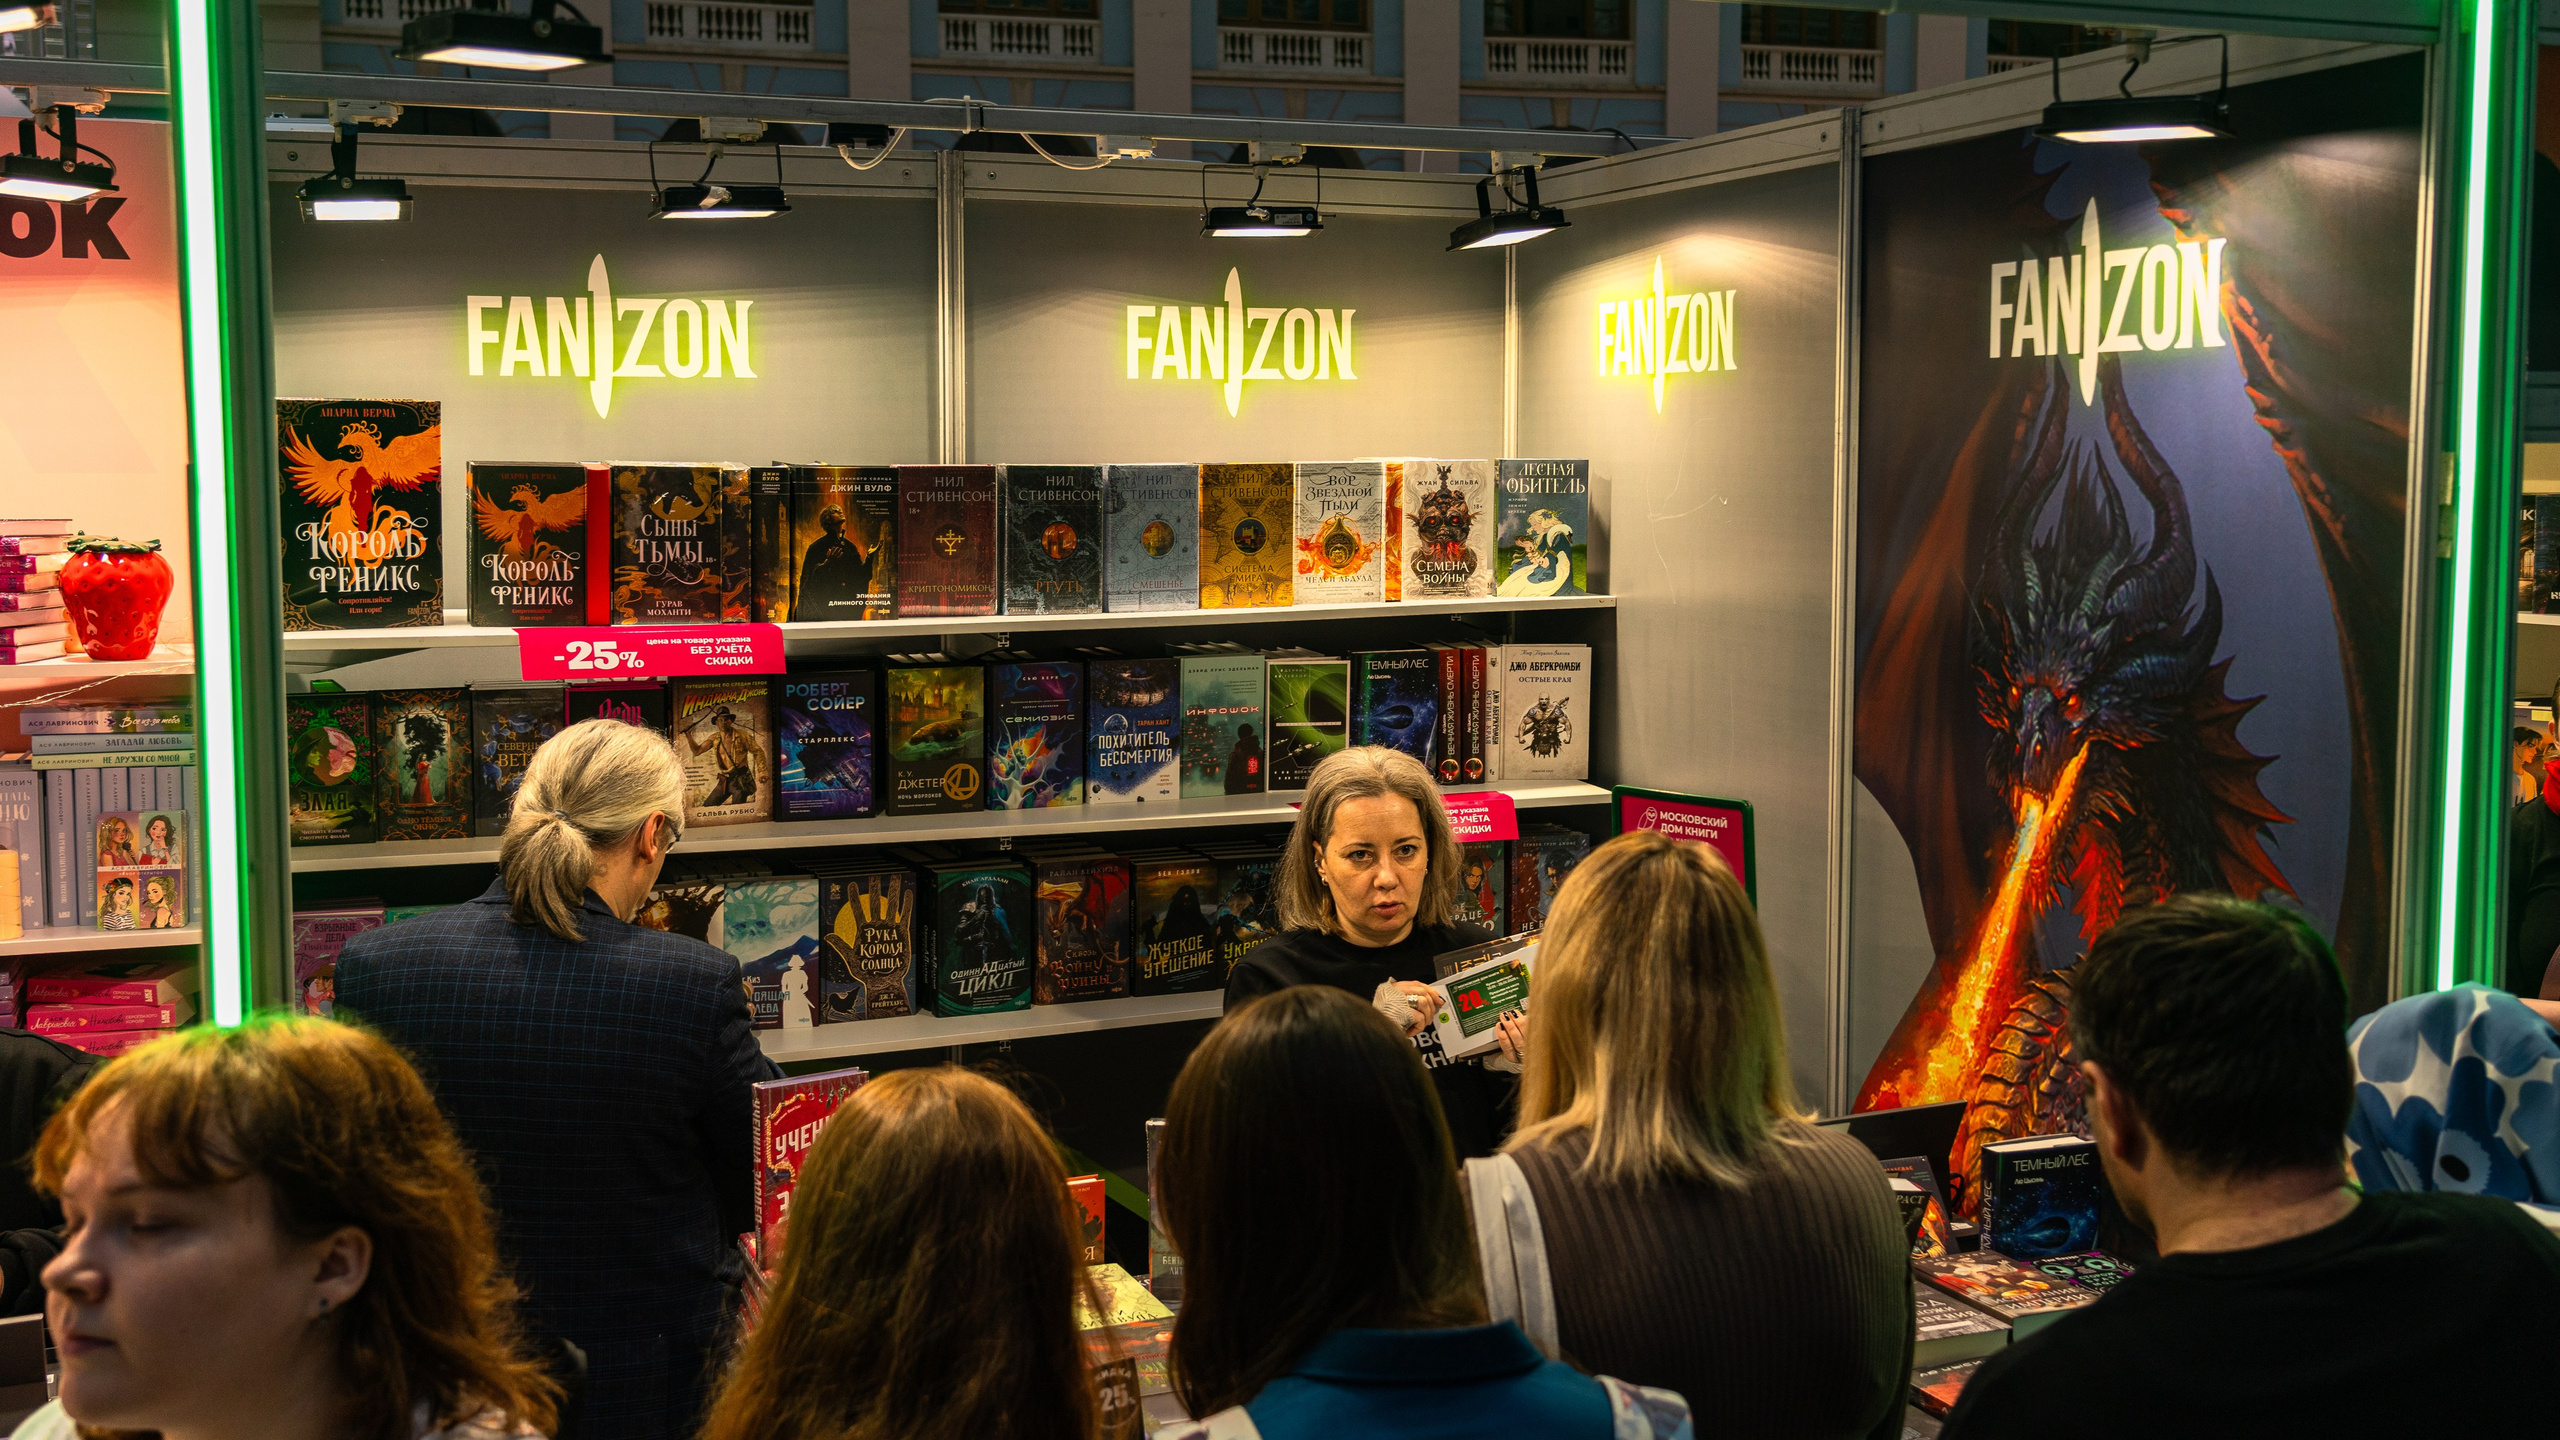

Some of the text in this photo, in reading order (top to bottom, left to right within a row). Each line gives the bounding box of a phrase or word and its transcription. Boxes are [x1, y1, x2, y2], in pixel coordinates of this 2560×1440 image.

[1990, 230, 2227, 364] FANZON
[467, 288, 758, 389] FANZON
[1599, 283, 1738, 386] FANZON
[1126, 297, 1358, 391] FANZON
[319, 407, 396, 418] АПАРНА ВЕРМА
[1518, 463, 1575, 476] ЛЕСНАЯ
[935, 476, 964, 487] НИЛ
[1046, 475, 1074, 486] НИЛ
[1146, 474, 1172, 486] НИЛ
[1237, 473, 1264, 484] НИЛ
[1324, 474, 1357, 487] ВОР
[864, 484, 892, 492] ВУЛФ
[1210, 486, 1289, 498] СТИВЕНСОН
[1506, 477, 1586, 494] ОБИТЕЛЬ
[906, 490, 992, 502] СТИВЕНСОН
[1018, 490, 1100, 501] СТИВЕНСОН
[1120, 488, 1197, 500] СТИВЕНСОН
[1305, 484, 1374, 501] ЗВЕЗДНОЙ
[1224, 564, 1274, 574] СИСТЕМА
[1416, 560, 1470, 573] СЕМЕНА
[309, 564, 421, 594] ФЕНИКС
[1235, 574, 1263, 582] МИРА
[1423, 571, 1465, 584] ВОЙНЫ
[908, 583, 991, 594] КРИПТОНОМИКОН
[1035, 580, 1083, 594] РТУТЬ
[1132, 580, 1184, 590] СМЕШЕНЬЕ
[490, 586, 574, 606] ФЕНИКС
[655, 600, 683, 608] ГУРАВ
[865, 599, 891, 607] СОЛНЦА
[350, 606, 382, 615] Или гори!
[647, 608, 692, 617] МОХАНТИ
[646, 637, 666, 646] цена
[682, 636, 714, 645] товаре
[715, 635, 751, 645] указана
[690, 642, 753, 655] БЕЗ УЧЁТА
[553, 640, 645, 671] -25%
[704, 655, 754, 667] СКИДКИ
[1366, 658, 1429, 671] ТЕМНЫЙ ЛЕС
[1509, 661, 1581, 672] ДЖО АБЕРКРОМБИ
[785, 682, 850, 698] РОБЕРТ
[681, 687, 768, 719] ИНДИАНА ДЖОНС
[806, 693, 866, 712] СОЙЕР
[1446, 654, 1455, 756] ВЕЧНАЯ ЖИЗНЬ СМЕРТИ
[1471, 654, 1480, 755] ВЕЧНАЯ ЖИЗНЬ СМЕРТИ
[1186, 705, 1260, 716] ИНФОШОК
[1492, 689, 1500, 745] ДЖО АБЕРКРОМБИ
[45, 719, 99, 727] ЛАВРИНОВИЧ
[119, 716, 140, 728] Все
[1005, 714, 1075, 723] СЕМИОЗИС
[1137, 719, 1155, 727] ТАРАН
[105, 738, 145, 747] ЗАГАДАЙ
[147, 736, 182, 745] ЛЮБОВЬ
[798, 736, 856, 744] СТАРПЛЕКС
[1098, 730, 1171, 750] ПОХИТИТЕЛЬ
[102, 755, 113, 764] НЕ
[114, 754, 144, 764] ДРУЖИ
[145, 754, 156, 763] СО
[157, 752, 180, 762] МНОЙ
[498, 753, 534, 767] ВЕТ
[1100, 748, 1173, 767] БЕССМЕРТИЯ
[907, 770, 914, 778] У.
[897, 778, 946, 791] ДЖЕТЕР
[301, 791, 348, 811] ЗЛАЯ
[730, 808, 755, 816] РУБИО
[397, 814, 452, 825] ОДНО ТЁМНОЕ
[1659, 810, 1728, 828] МОСКОВСКИЙ
[413, 823, 438, 831] ОКНО
[1452, 824, 1492, 835] СКИДКИ
[1660, 823, 1718, 839] ДОМ КНИГИ
[1176, 868, 1201, 876] ГЭЛЛИ
[314, 922, 357, 933] ВЗРЫВНЫЕ
[325, 933, 347, 943] ДЕЛА
[863, 928, 898, 943] РУКА
[860, 942, 903, 958] КОРОЛЯ
[1148, 935, 1204, 961] ЖУТКОЕ
[861, 957, 902, 973] СОЛНЦА
[1143, 949, 1214, 979] УТЕШЕНИЕ
[958, 971, 1014, 996] ЦИКЛ
[754, 1002, 779, 1014] ЛЕВА
[752, 1098, 762, 1164] УЧЕНИЦА
[2012, 1153, 2090, 1173] ТЕМНЫЙ ЛЕС
[2014, 1176, 2044, 1185] Лю Цысинь
[1992, 1287, 2080, 1305] ИСПЫТАНИЕ
[2005, 1293, 2088, 1310] ИМПЕРИИ
